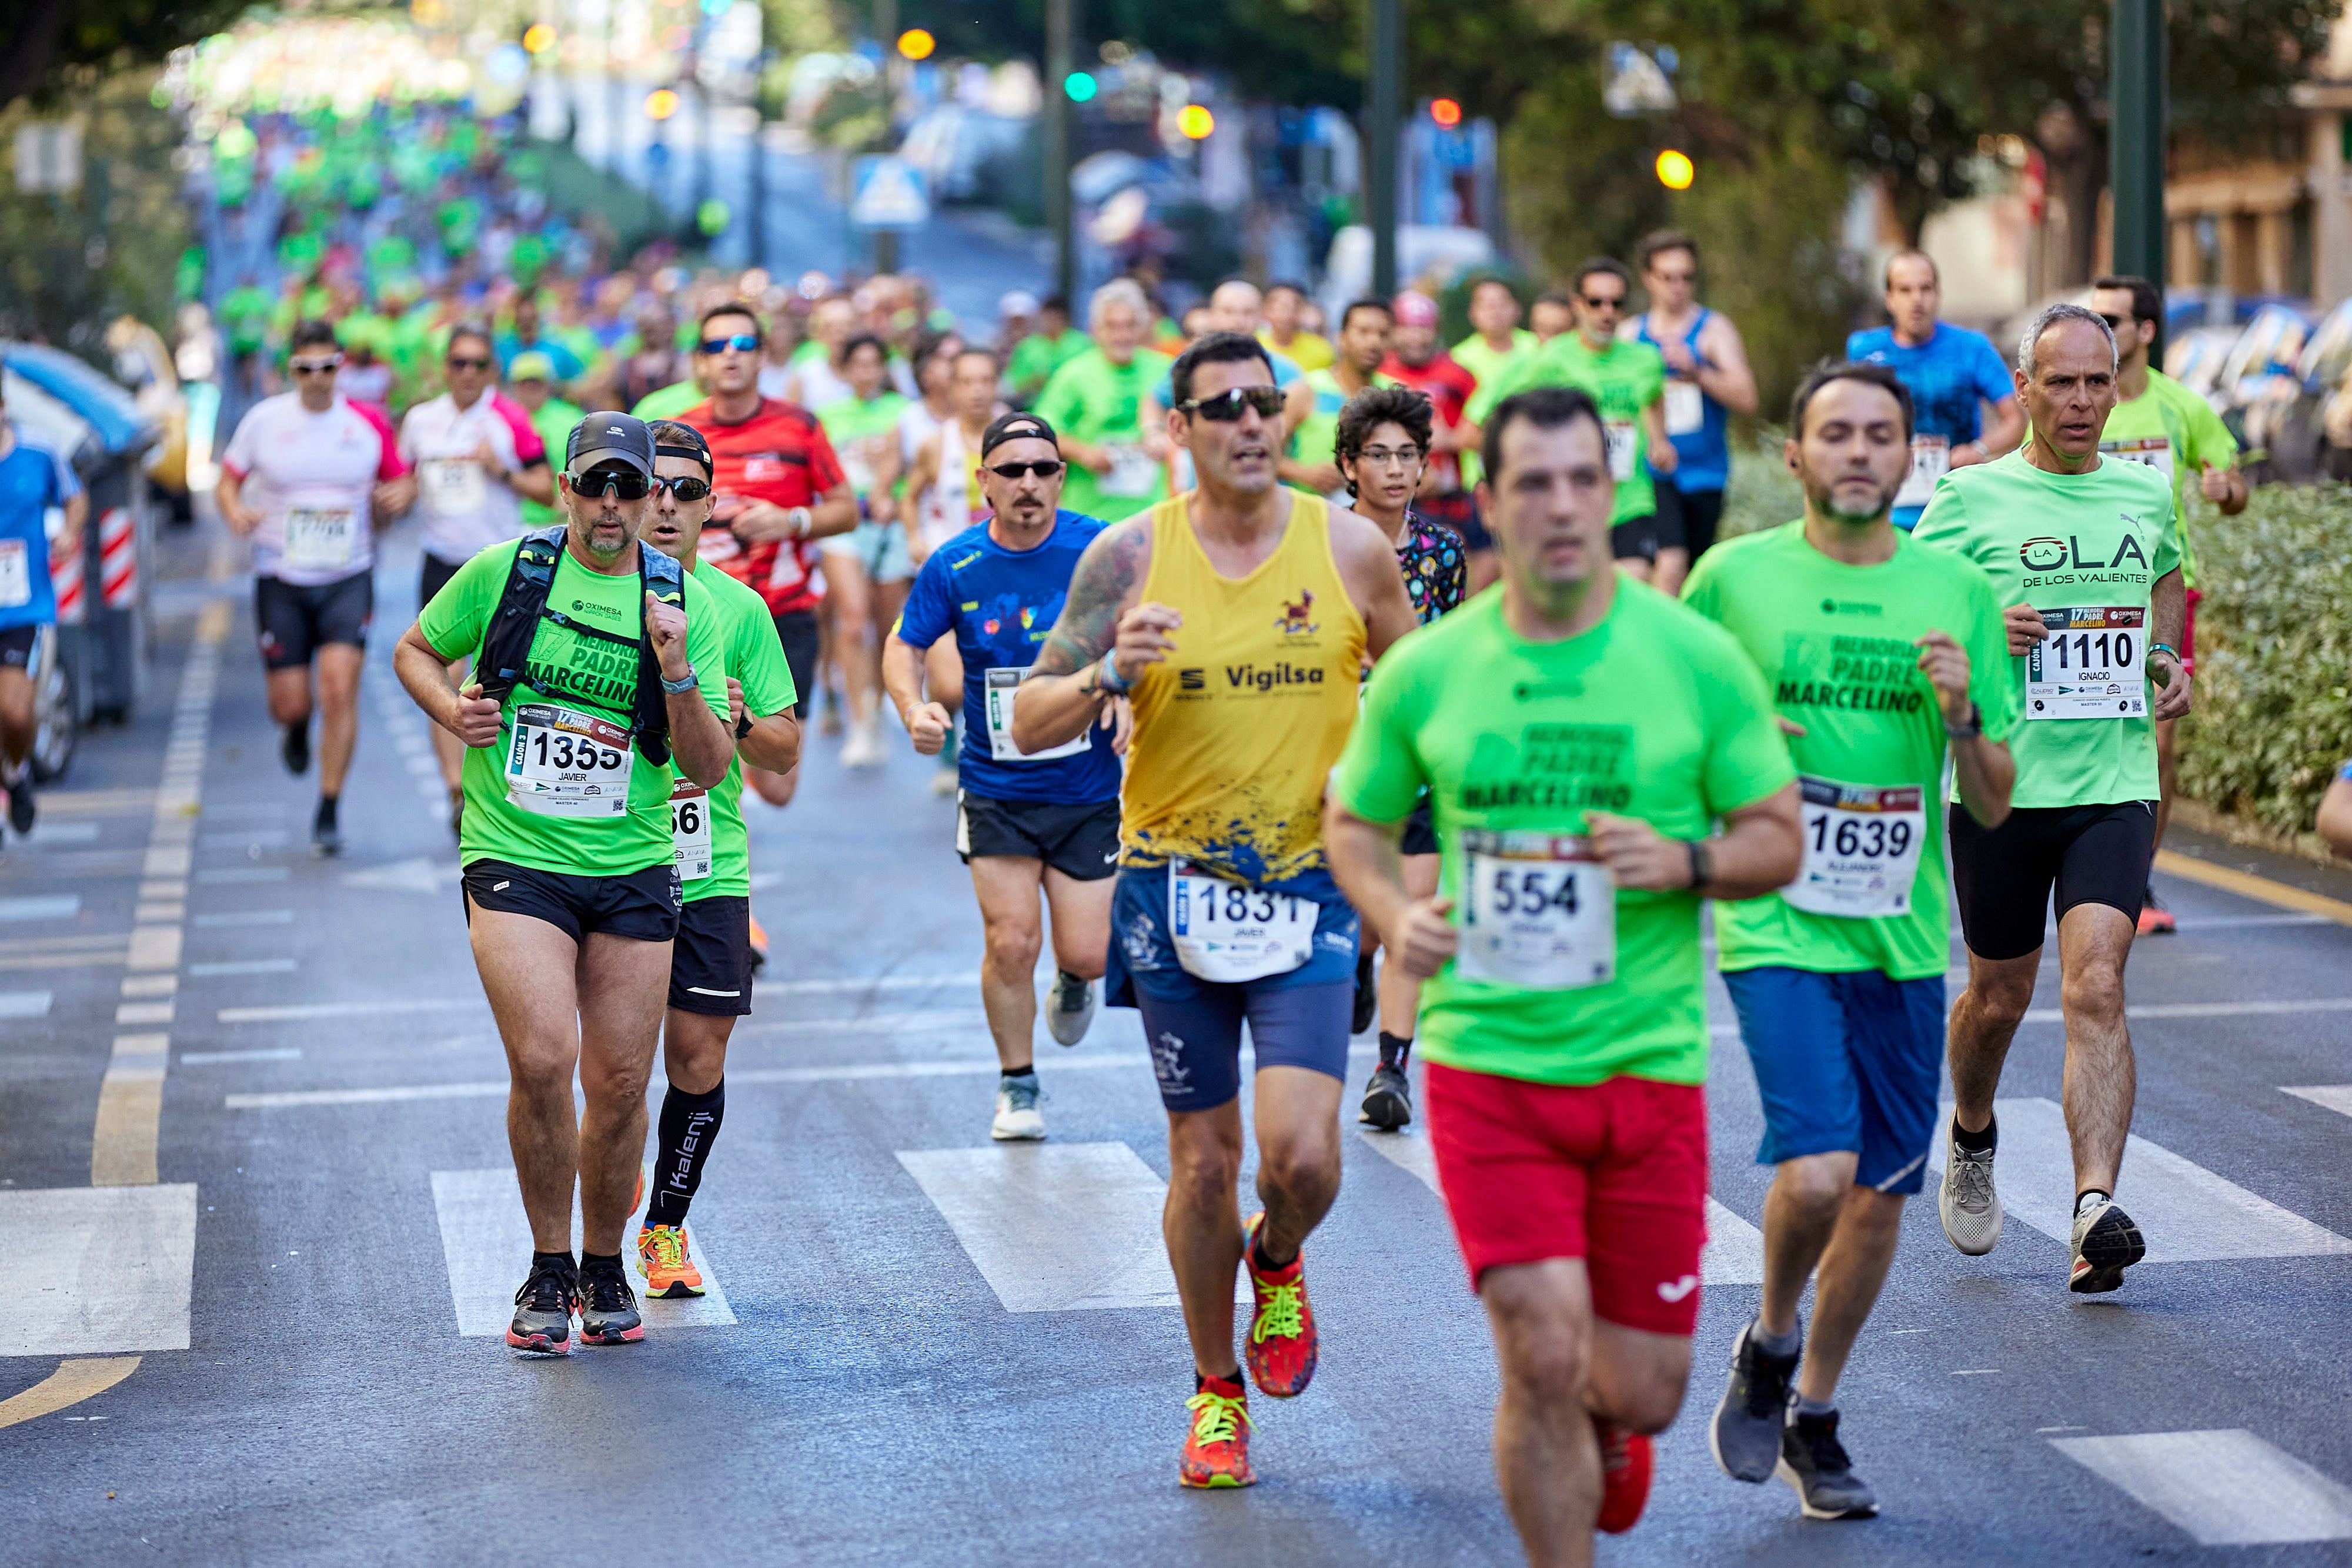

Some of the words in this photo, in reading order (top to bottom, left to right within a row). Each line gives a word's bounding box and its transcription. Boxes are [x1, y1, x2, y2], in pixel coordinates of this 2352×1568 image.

[2020, 533, 2148, 571] OLA
[2034, 549, 2053, 557] LA
[2023, 577, 2041, 587] DE
[2045, 574, 2074, 585] LOS
[2079, 573, 2147, 583] VALIENTES
[586, 602, 622, 616] OXIMESA
[2071, 608, 2084, 621] 17
[2052, 633, 2133, 668] 1110
[1225, 661, 1324, 691] Vigilsa
[2079, 671, 2110, 681] IGNACIO
[1775, 680, 1923, 714] MARCELINO
[527, 707, 552, 717] OXIMESA
[557, 710, 571, 723] 17
[569, 717, 592, 730] PADRE
[514, 744, 526, 765] CAJÓN
[534, 731, 622, 770] 1355
[559, 772, 587, 781] JAVIER
[1810, 813, 1912, 858] 1639
[1494, 869, 1579, 917] 554
[1200, 884, 1298, 922] 1831
